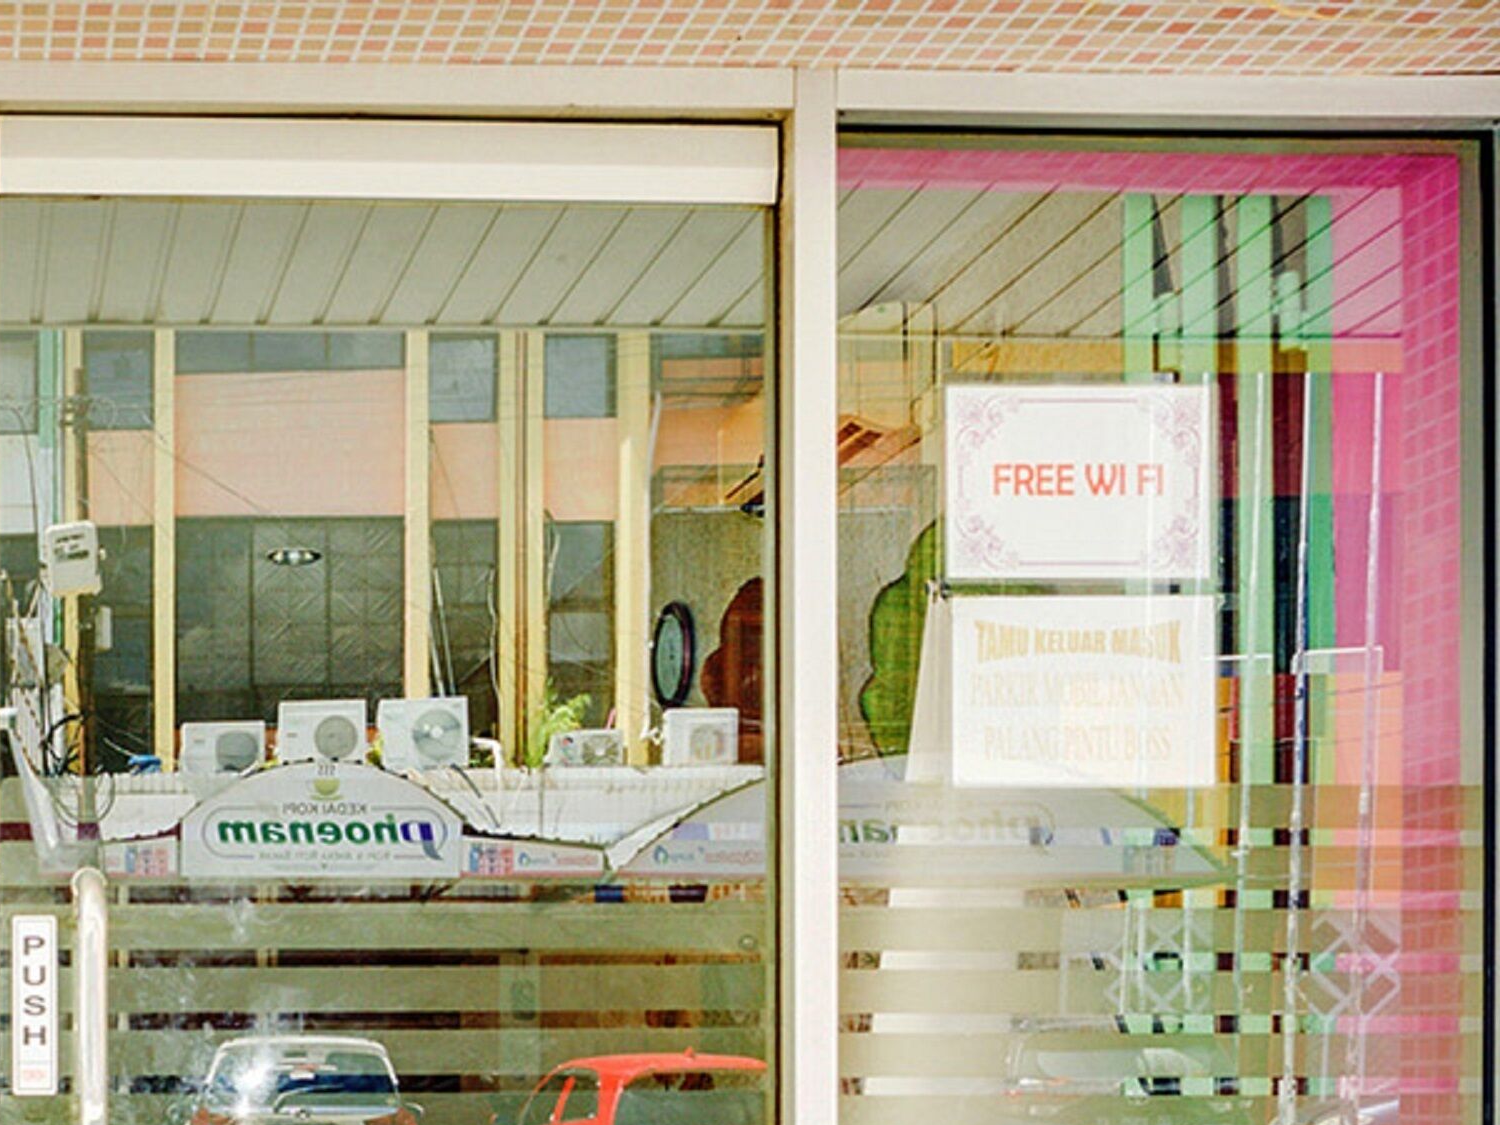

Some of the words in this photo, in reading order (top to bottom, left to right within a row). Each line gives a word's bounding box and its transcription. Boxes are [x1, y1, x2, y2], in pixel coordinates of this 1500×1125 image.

[993, 463, 1074, 496] FREE
[1084, 463, 1126, 496] WI
[1137, 463, 1164, 496] FI
[974, 619, 1030, 663] TAMU
[1034, 627, 1107, 656] KELUAR
[1110, 619, 1181, 664] MASUK
[22, 935, 47, 1047] PUSH
